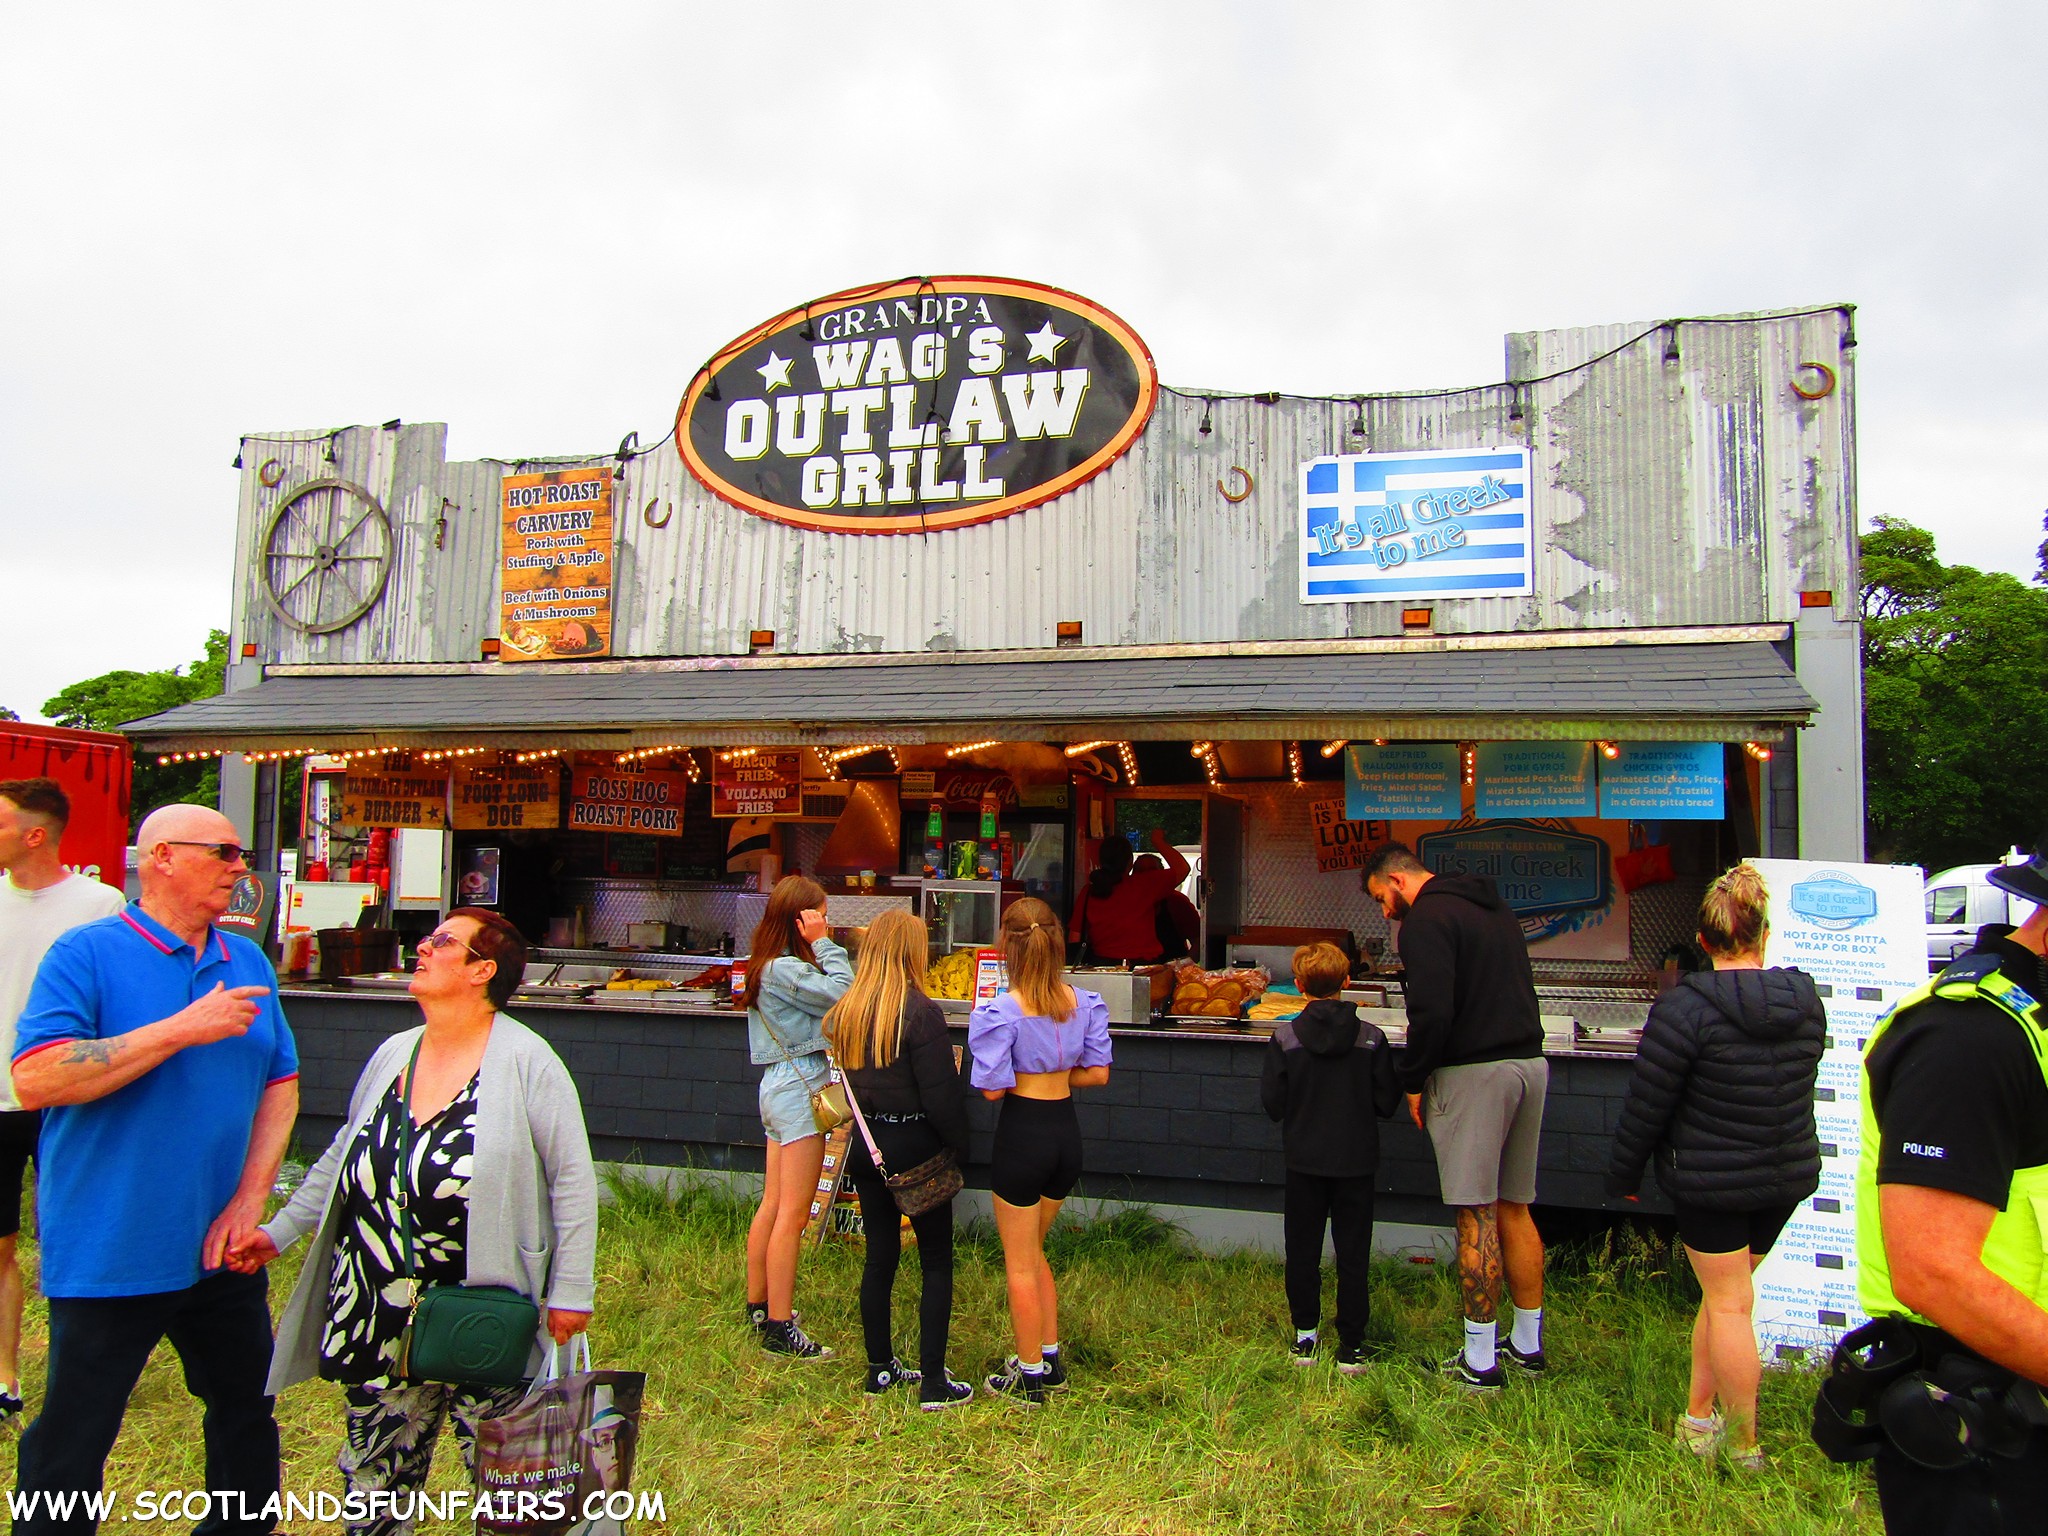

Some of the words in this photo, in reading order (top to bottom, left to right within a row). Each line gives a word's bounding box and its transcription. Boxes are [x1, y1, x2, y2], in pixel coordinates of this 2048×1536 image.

[820, 297, 994, 341] GRANDPA
[812, 325, 1005, 389] WAG'S
[724, 368, 1091, 461] OUTLAW
[801, 444, 1005, 509] GRILL
[509, 486, 542, 507] HOT
[547, 482, 601, 504] ROAST
[517, 510, 593, 534] CARVERY
[1312, 520, 1363, 556] It's
[1368, 502, 1408, 540] all
[1411, 475, 1511, 525] Greek
[526, 537, 554, 550] Pork
[556, 534, 584, 547] with
[1370, 540, 1407, 569] to
[1412, 524, 1465, 559] me
[508, 555, 554, 569] Stuffing
[557, 554, 568, 565] &
[569, 551, 604, 568] Apple
[505, 591, 532, 604] Beef
[534, 589, 560, 602] with
[564, 586, 606, 599] Onions
[513, 610, 523, 621] &
[524, 606, 596, 620] Mushrooms
[732, 755, 777, 768] BACON
[1380, 751, 1400, 759] DEEP
[1403, 751, 1427, 759] FRIED
[1503, 752, 1566, 761] TRADITIONAL
[1629, 752, 1694, 760] TRADITIONAL
[383, 754, 412, 771] THE
[613, 752, 646, 774] THE
[1363, 762, 1409, 770] HALLOUMI
[1413, 762, 1444, 770] GYROS
[1504, 764, 1529, 772] PORK
[1532, 763, 1566, 771] GYROS
[1623, 764, 1663, 772] CHICKEN
[1665, 763, 1700, 771] GYROS
[736, 770, 774, 782] FRIES
[1359, 773, 1381, 781] Deep
[1485, 775, 1530, 784] Marinated
[1603, 775, 1650, 783] Marinated
[1652, 775, 1692, 784] Chicken,
[1694, 775, 1722, 784] Fries,
[348, 777, 400, 796] ULTIMATE
[404, 778, 446, 797] OUTLAW
[463, 784, 502, 803] FOOT
[507, 783, 549, 803] LONG
[587, 777, 628, 800] BOSS
[632, 780, 669, 803] HOG
[725, 787, 787, 800] VOLCANO
[1361, 784, 1386, 792] Fries,
[1418, 784, 1446, 792] Salad,
[1487, 787, 1514, 795] Mixed
[1517, 786, 1544, 795] Salad,
[1548, 785, 1584, 794] Tzatziki
[1643, 787, 1671, 795] Salad,
[1675, 787, 1712, 795] Tzatziki
[1378, 795, 1412, 803] Tzatziki
[1415, 795, 1422, 803] in
[1504, 798, 1531, 806] Greek
[1534, 798, 1557, 807] pitta
[1559, 797, 1585, 805] bread
[1611, 798, 1619, 806] in
[1660, 799, 1684, 807] pitta
[363, 800, 422, 823] BURGER
[736, 801, 774, 814] FRIES
[1315, 802, 1330, 810] ALL
[1365, 805, 1390, 813] Greek
[1392, 805, 1414, 814] pitta
[487, 805, 524, 826] DOG
[574, 803, 627, 827] ROAST
[629, 807, 678, 830] PORK
[1316, 811, 1331, 824] IS
[1320, 820, 1380, 846] LOVE
[1333, 846, 1344, 856] IS
[1350, 844, 1370, 854] ALL
[1321, 857, 1348, 869] YOU
[1434, 853, 1468, 875] It's
[1477, 854, 1501, 876] all
[1511, 855, 1585, 878] Greek
[1504, 882, 1542, 900] me
[1818, 893, 1829, 903] all
[1833, 894, 1865, 905] Greek
[1816, 903, 1827, 912] to
[1830, 904, 1847, 913] me
[1783, 931, 1807, 939] HOT
[1811, 932, 1851, 942] GYROS
[1854, 935, 1887, 944] PITTA
[1794, 941, 1828, 951] WRAP
[1832, 944, 1848, 952] OR
[1852, 945, 1876, 954] BOX
[1782, 956, 1835, 965] TRADITIONAL
[1860, 961, 1886, 969] GYROS
[1832, 967, 1851, 975] Pork,
[1873, 979, 1892, 987] pitta
[1828, 1018, 1858, 1026] Chicken,
[1819, 1124, 1854, 1134] Halloumi,
[1903, 1142, 1944, 1158] POLICE
[1806, 1224, 1827, 1232] FRIED
[1791, 1232, 1811, 1240] Deep
[1785, 1241, 1808, 1249] Salad,
[1812, 1243, 1842, 1252] Tzatziki
[1845, 1245, 1852, 1253] in
[1783, 1253, 1814, 1262] GYROS
[1762, 1284, 1795, 1293] Chicken,
[1797, 1288, 1818, 1297] Pork,
[1820, 1291, 1858, 1301] Halloumi,
[1786, 1295, 1811, 1306] Salad,
[1814, 1299, 1845, 1309] Tzatziki
[1785, 1309, 1816, 1319] GYROS
[485, 1467, 519, 1485] What
[524, 1470, 544, 1483] we
[547, 1460, 584, 1480] make,
